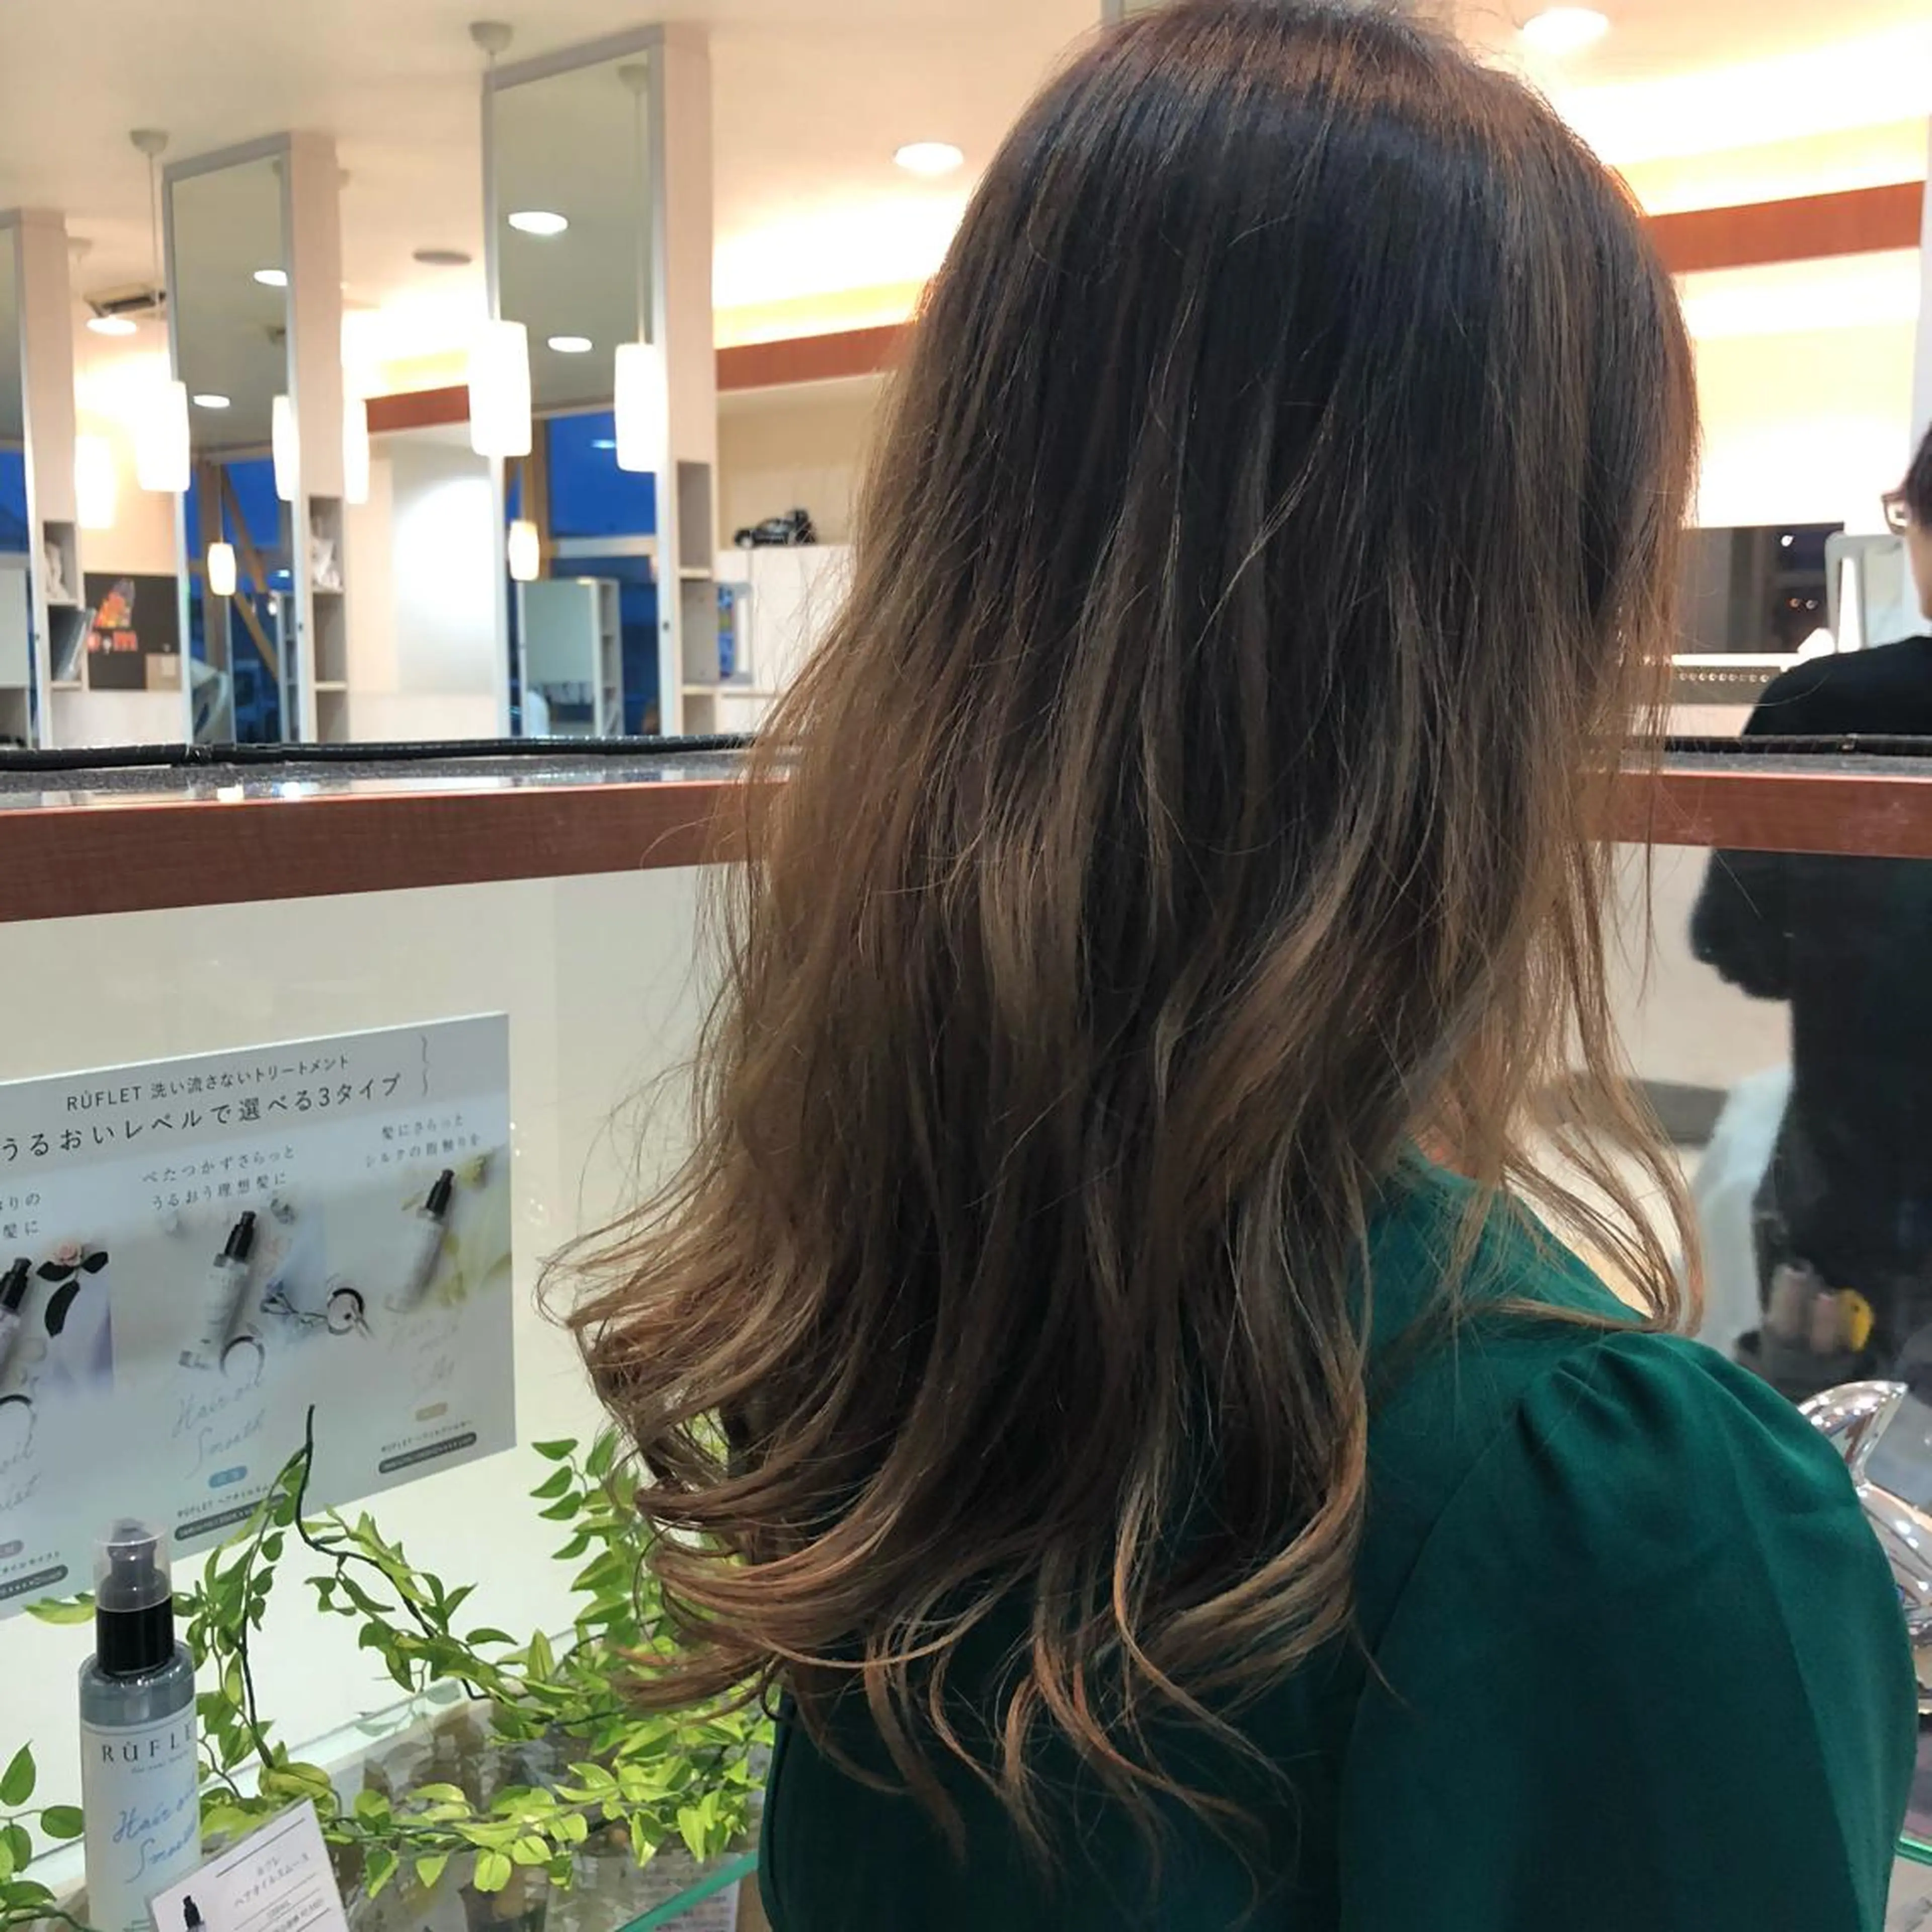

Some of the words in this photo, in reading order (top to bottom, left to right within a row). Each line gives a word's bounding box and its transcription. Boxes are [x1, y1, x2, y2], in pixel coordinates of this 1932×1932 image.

[151, 1056, 348, 1100] 洗い流さないトリートメント
[0, 1192, 41, 1211] りの
